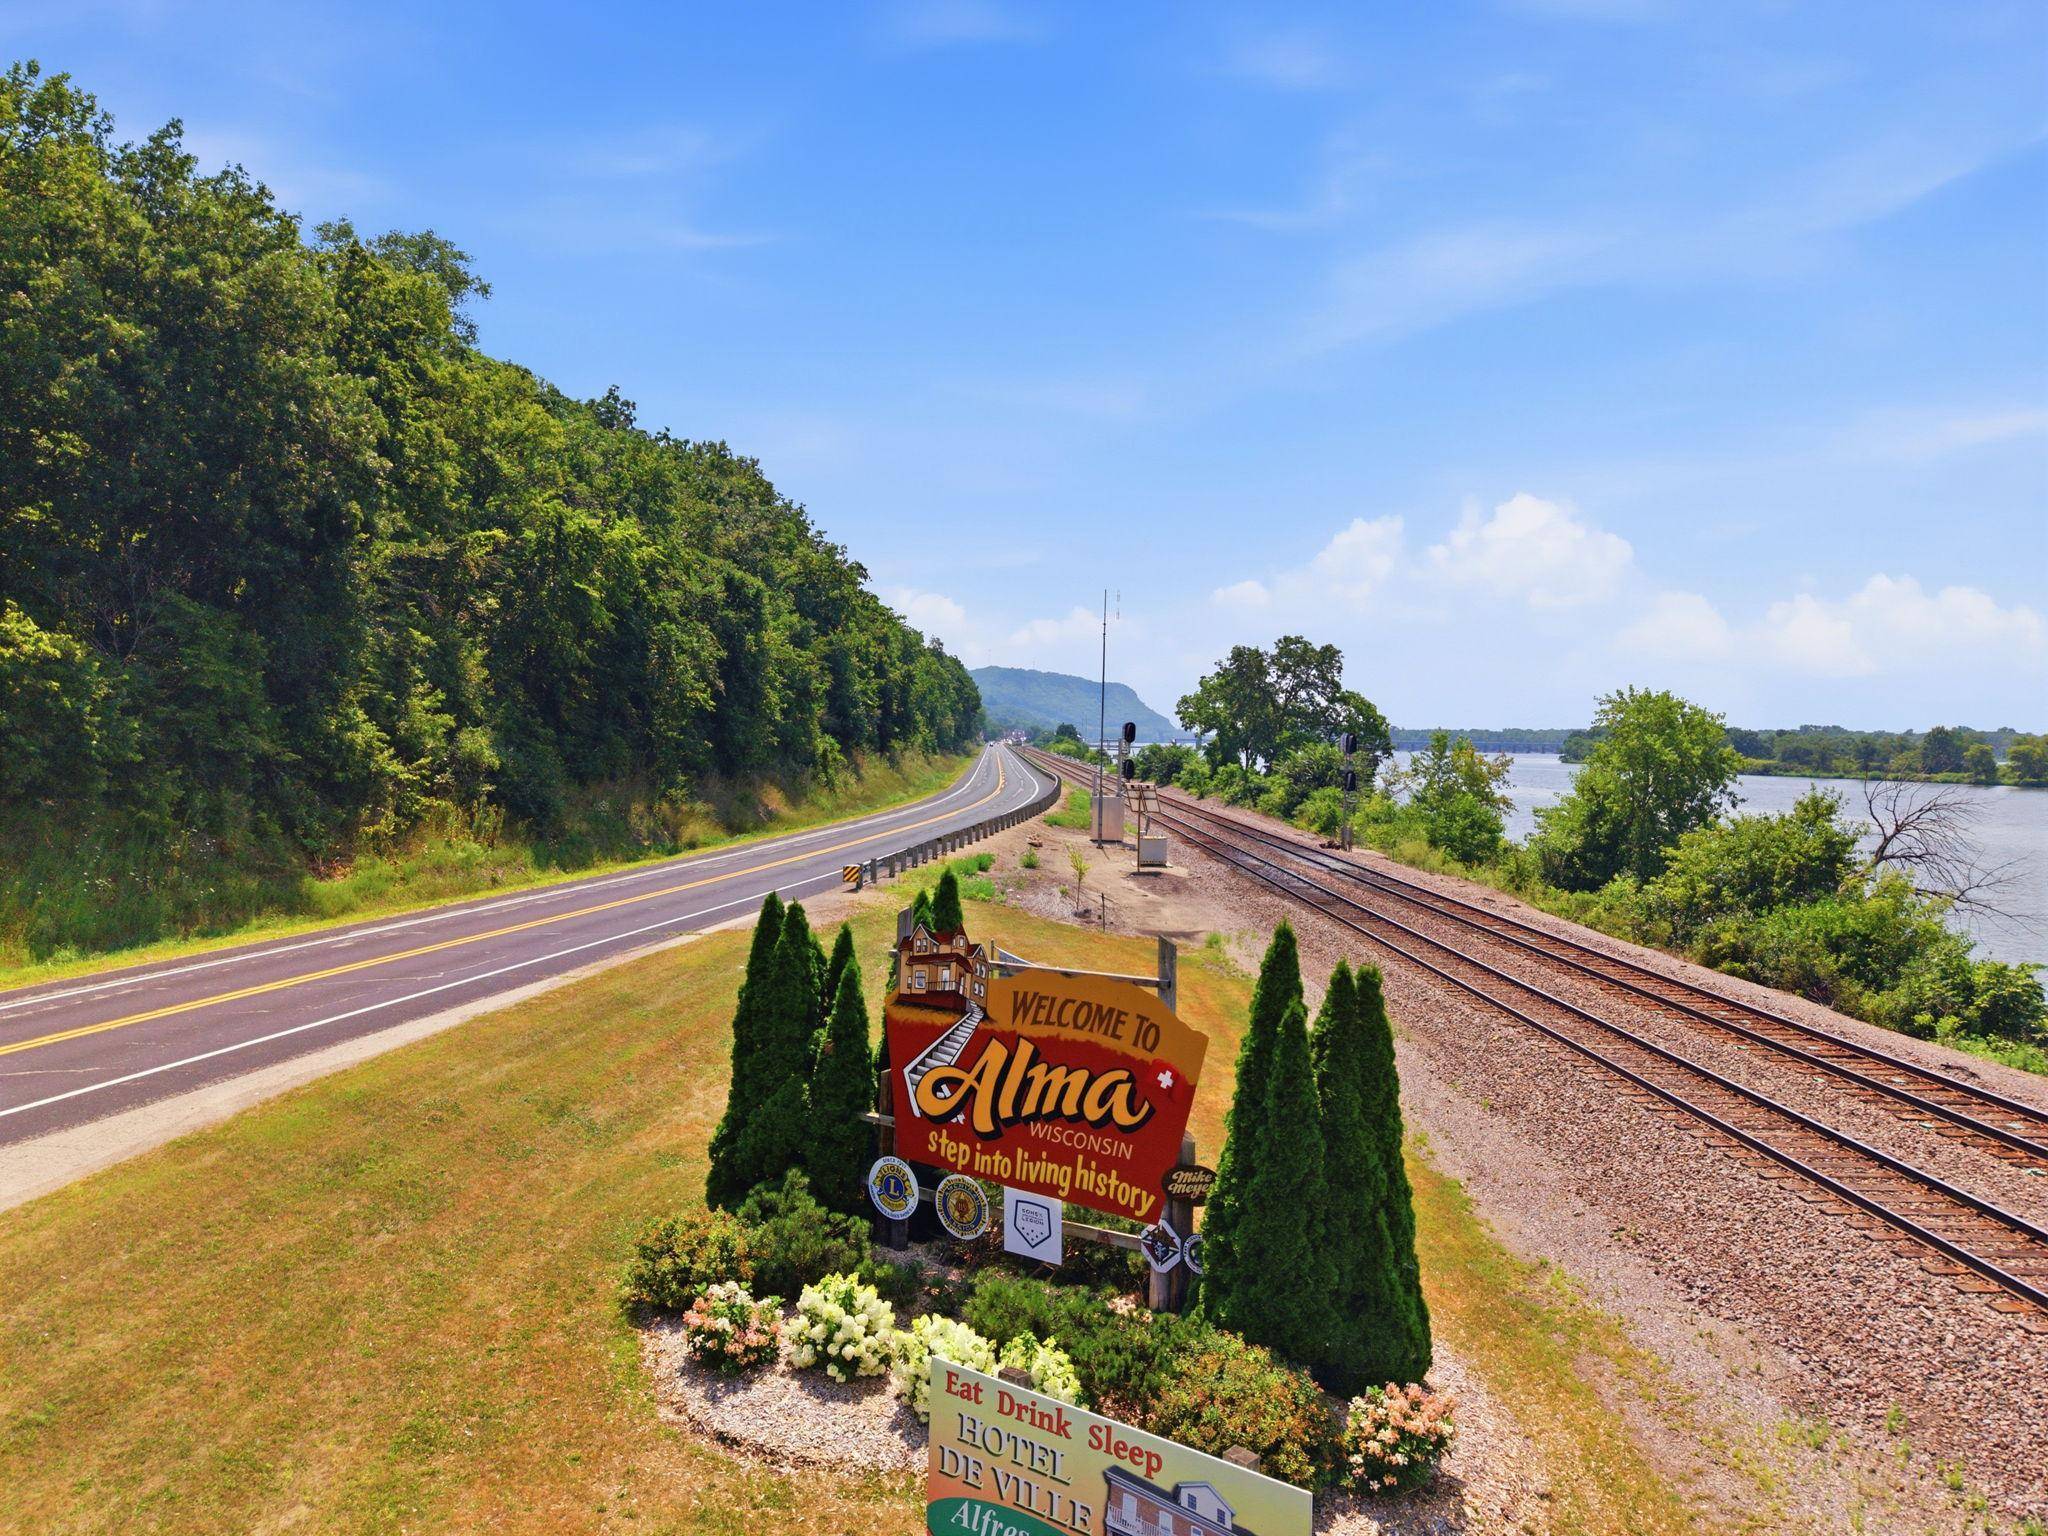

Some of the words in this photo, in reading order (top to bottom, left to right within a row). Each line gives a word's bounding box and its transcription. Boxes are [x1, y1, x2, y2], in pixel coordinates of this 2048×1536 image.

[1012, 990, 1129, 1040] WELCOME
[1132, 1013, 1160, 1054] TO
[915, 1037, 1154, 1137] Alma
[881, 1165, 907, 1180] LIONS
[1030, 1121, 1133, 1160] WISCONSIN
[889, 1179, 900, 1196] L
[928, 1129, 970, 1171] step
[974, 1142, 1012, 1180] into
[1015, 1147, 1072, 1197] living
[1076, 1154, 1155, 1217] history
[1168, 1182, 1209, 1199] Meye
[1172, 1170, 1212, 1183] Mike
[945, 1370, 983, 1405] Eat
[997, 1390, 1072, 1439] Drink
[1087, 1424, 1163, 1479] Sleep
[957, 1412, 1071, 1486] HOTEL
[939, 1445, 984, 1490] DE
[991, 1466, 1094, 1536] VILLE
